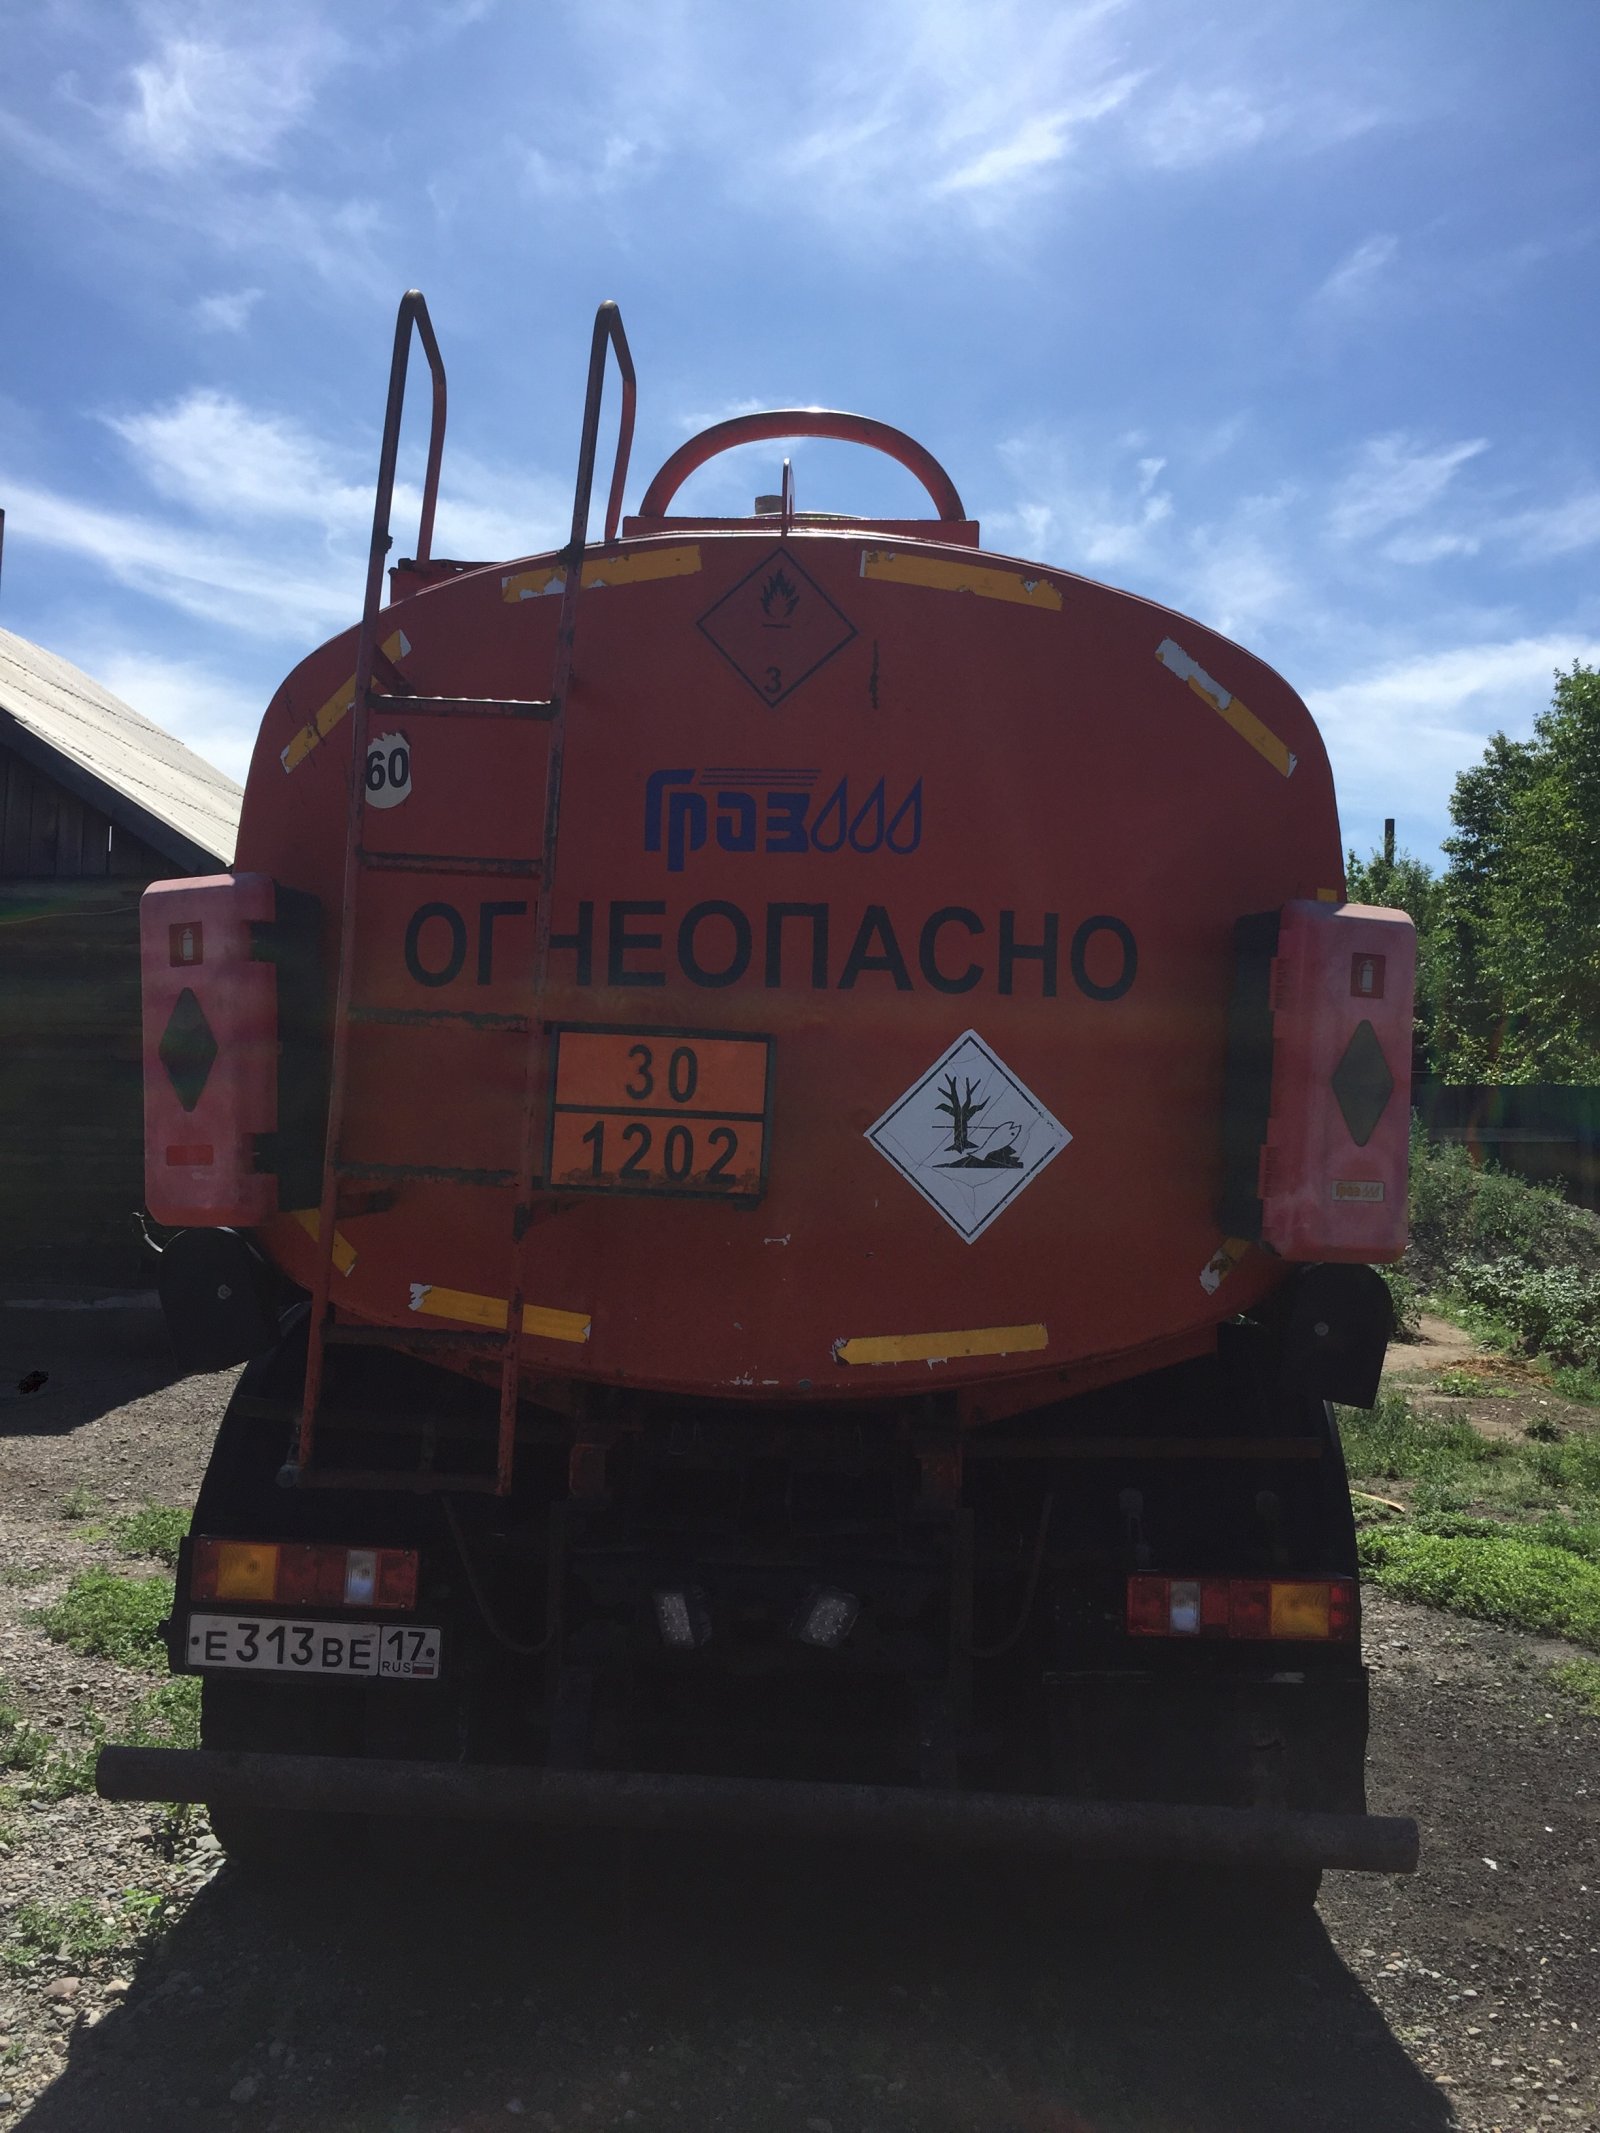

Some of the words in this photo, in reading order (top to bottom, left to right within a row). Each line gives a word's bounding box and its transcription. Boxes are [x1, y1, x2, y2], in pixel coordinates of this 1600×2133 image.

[764, 666, 782, 694] 3
[366, 747, 409, 791] 60
[404, 901, 1138, 1002] ОГНЕОПАСНО
[625, 1044, 698, 1103] 30
[582, 1120, 739, 1185] 1202
[382, 1661, 412, 1674] RUS
[387, 1631, 426, 1662] 17
